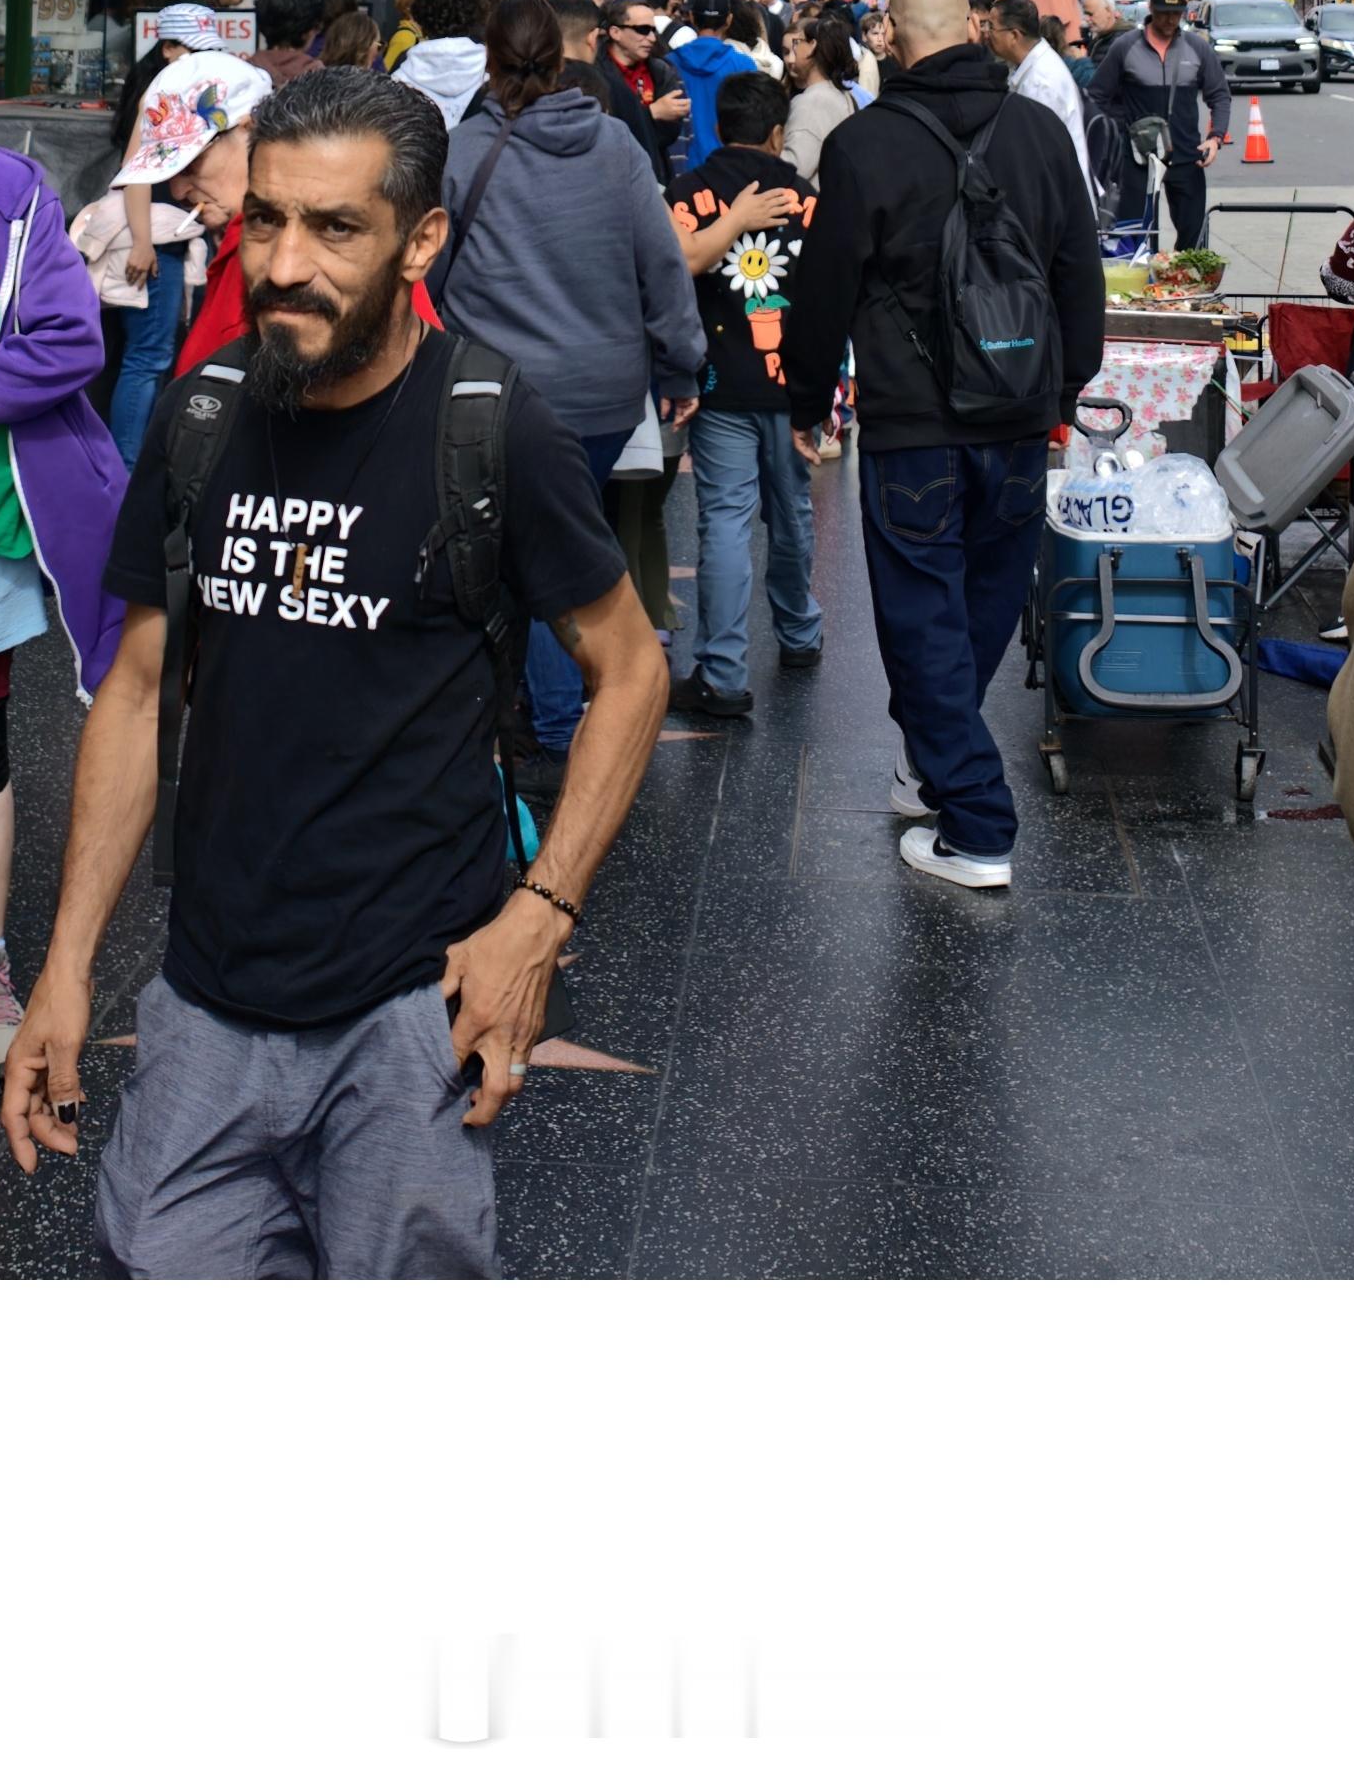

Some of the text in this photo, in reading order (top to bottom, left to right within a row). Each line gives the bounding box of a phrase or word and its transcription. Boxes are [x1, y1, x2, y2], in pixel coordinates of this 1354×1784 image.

[143, 18, 251, 40] HIES
[225, 492, 364, 539] HAPPY
[220, 535, 349, 585] IS THE
[277, 584, 390, 631] SEXY
